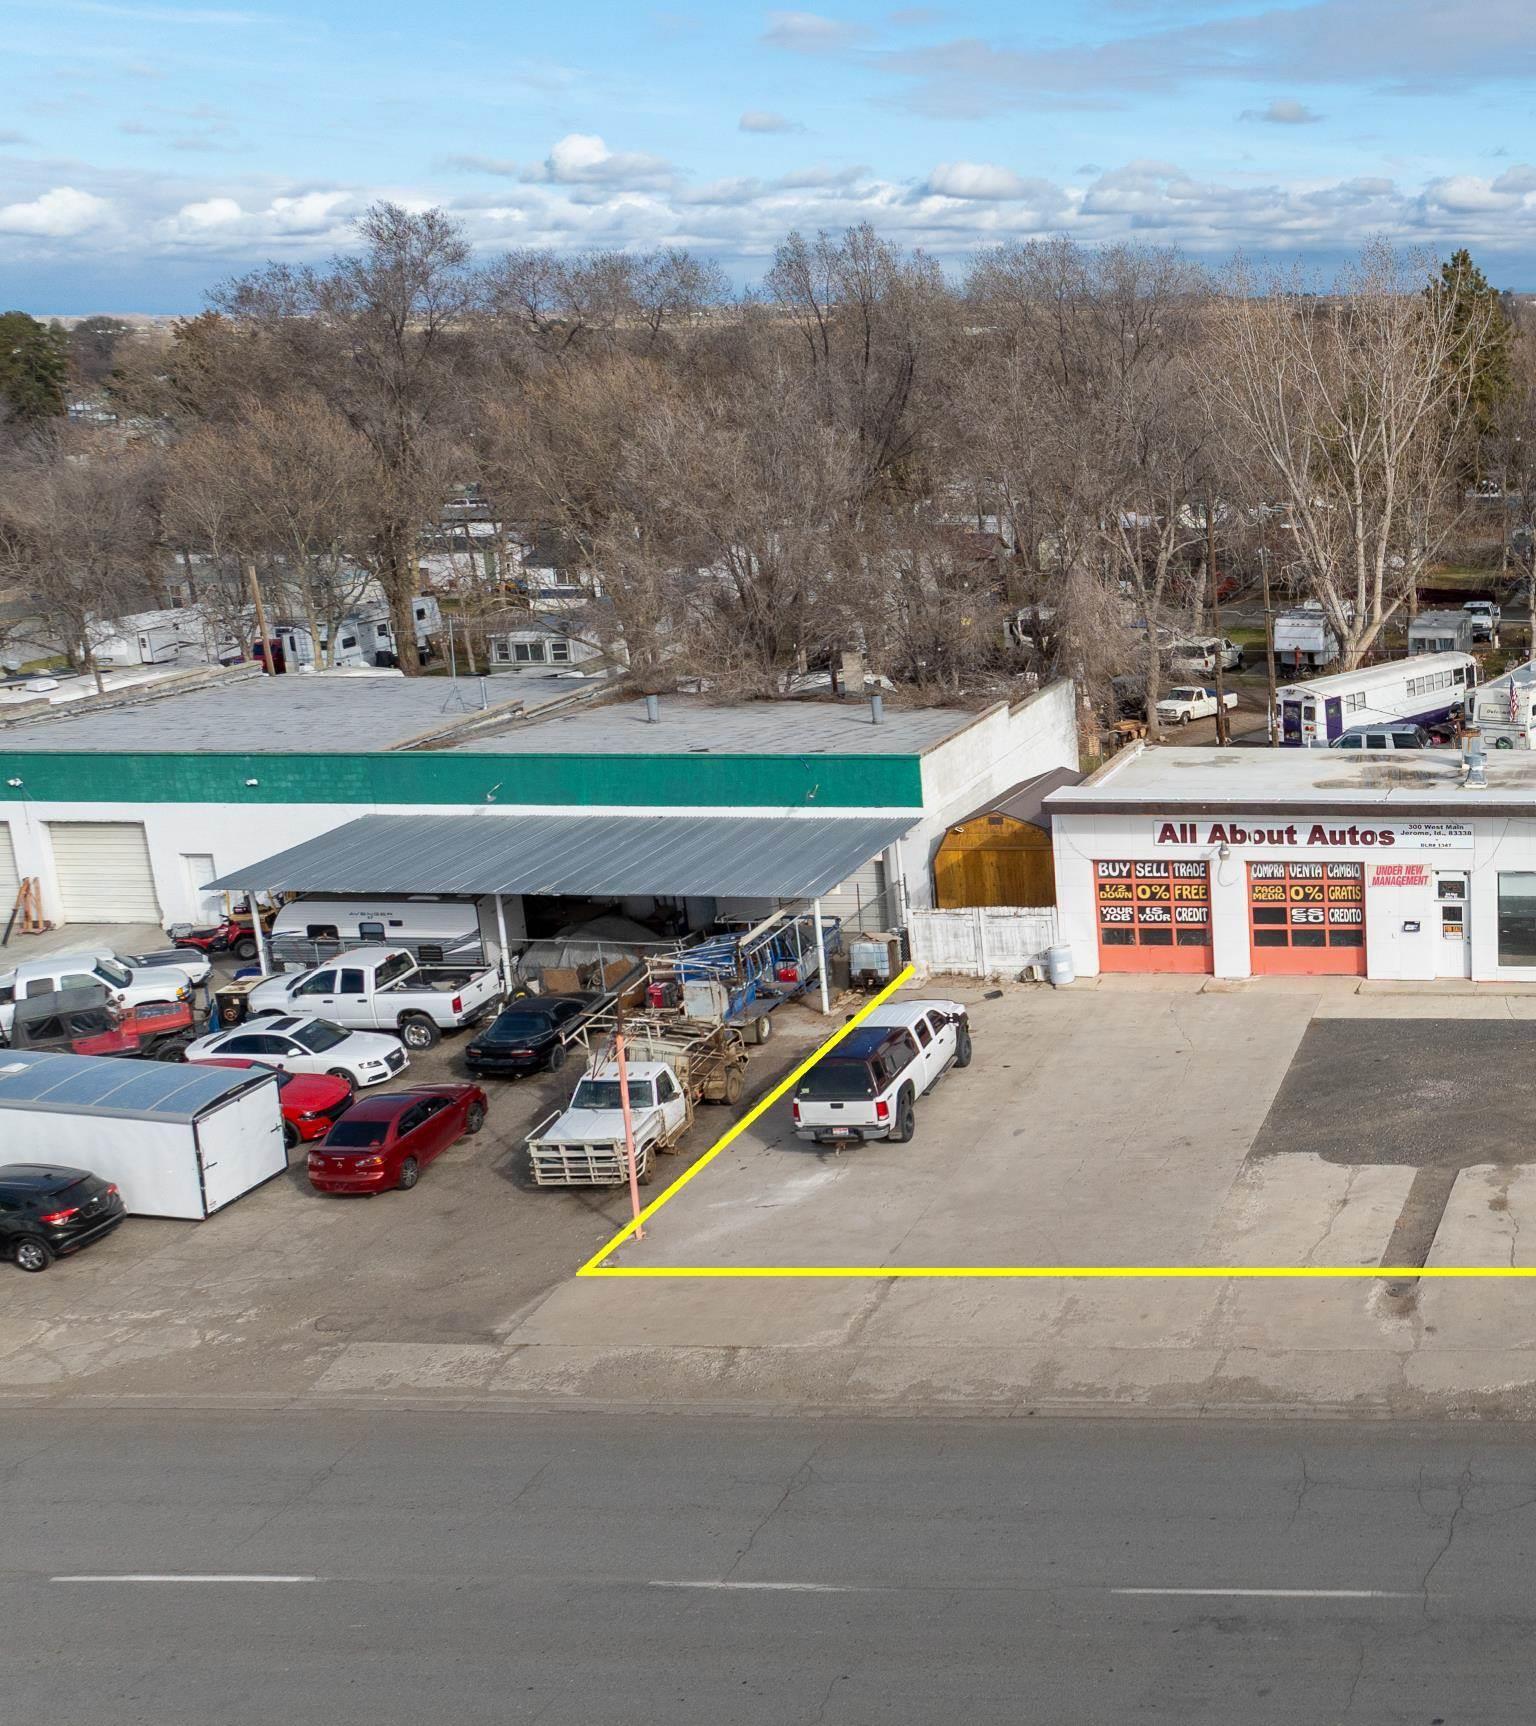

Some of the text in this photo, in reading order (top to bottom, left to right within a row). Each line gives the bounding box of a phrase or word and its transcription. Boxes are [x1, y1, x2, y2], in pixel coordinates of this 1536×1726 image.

[1157, 823, 1396, 846] All About Autos
[1098, 862, 1206, 877] BUY SELL TRADE
[1251, 863, 1361, 878] COMPRA VENTA CAMBIO
[1376, 865, 1424, 876] UNDER NEW
[1372, 875, 1429, 887] MANAGEMENT
[1105, 884, 1126, 892] 1/2
[1137, 884, 1208, 900] 0% FREE
[1290, 886, 1361, 900] 0% GRATIS
[1100, 891, 1132, 899] DOWN
[1252, 892, 1286, 900] MEDIO
[1101, 906, 1133, 914] YOUR
[1145, 906, 1164, 914] IS
[1175, 907, 1208, 922] CREDIT
[1328, 908, 1362, 923] CREDITO
[1291, 915, 1324, 923] SU
